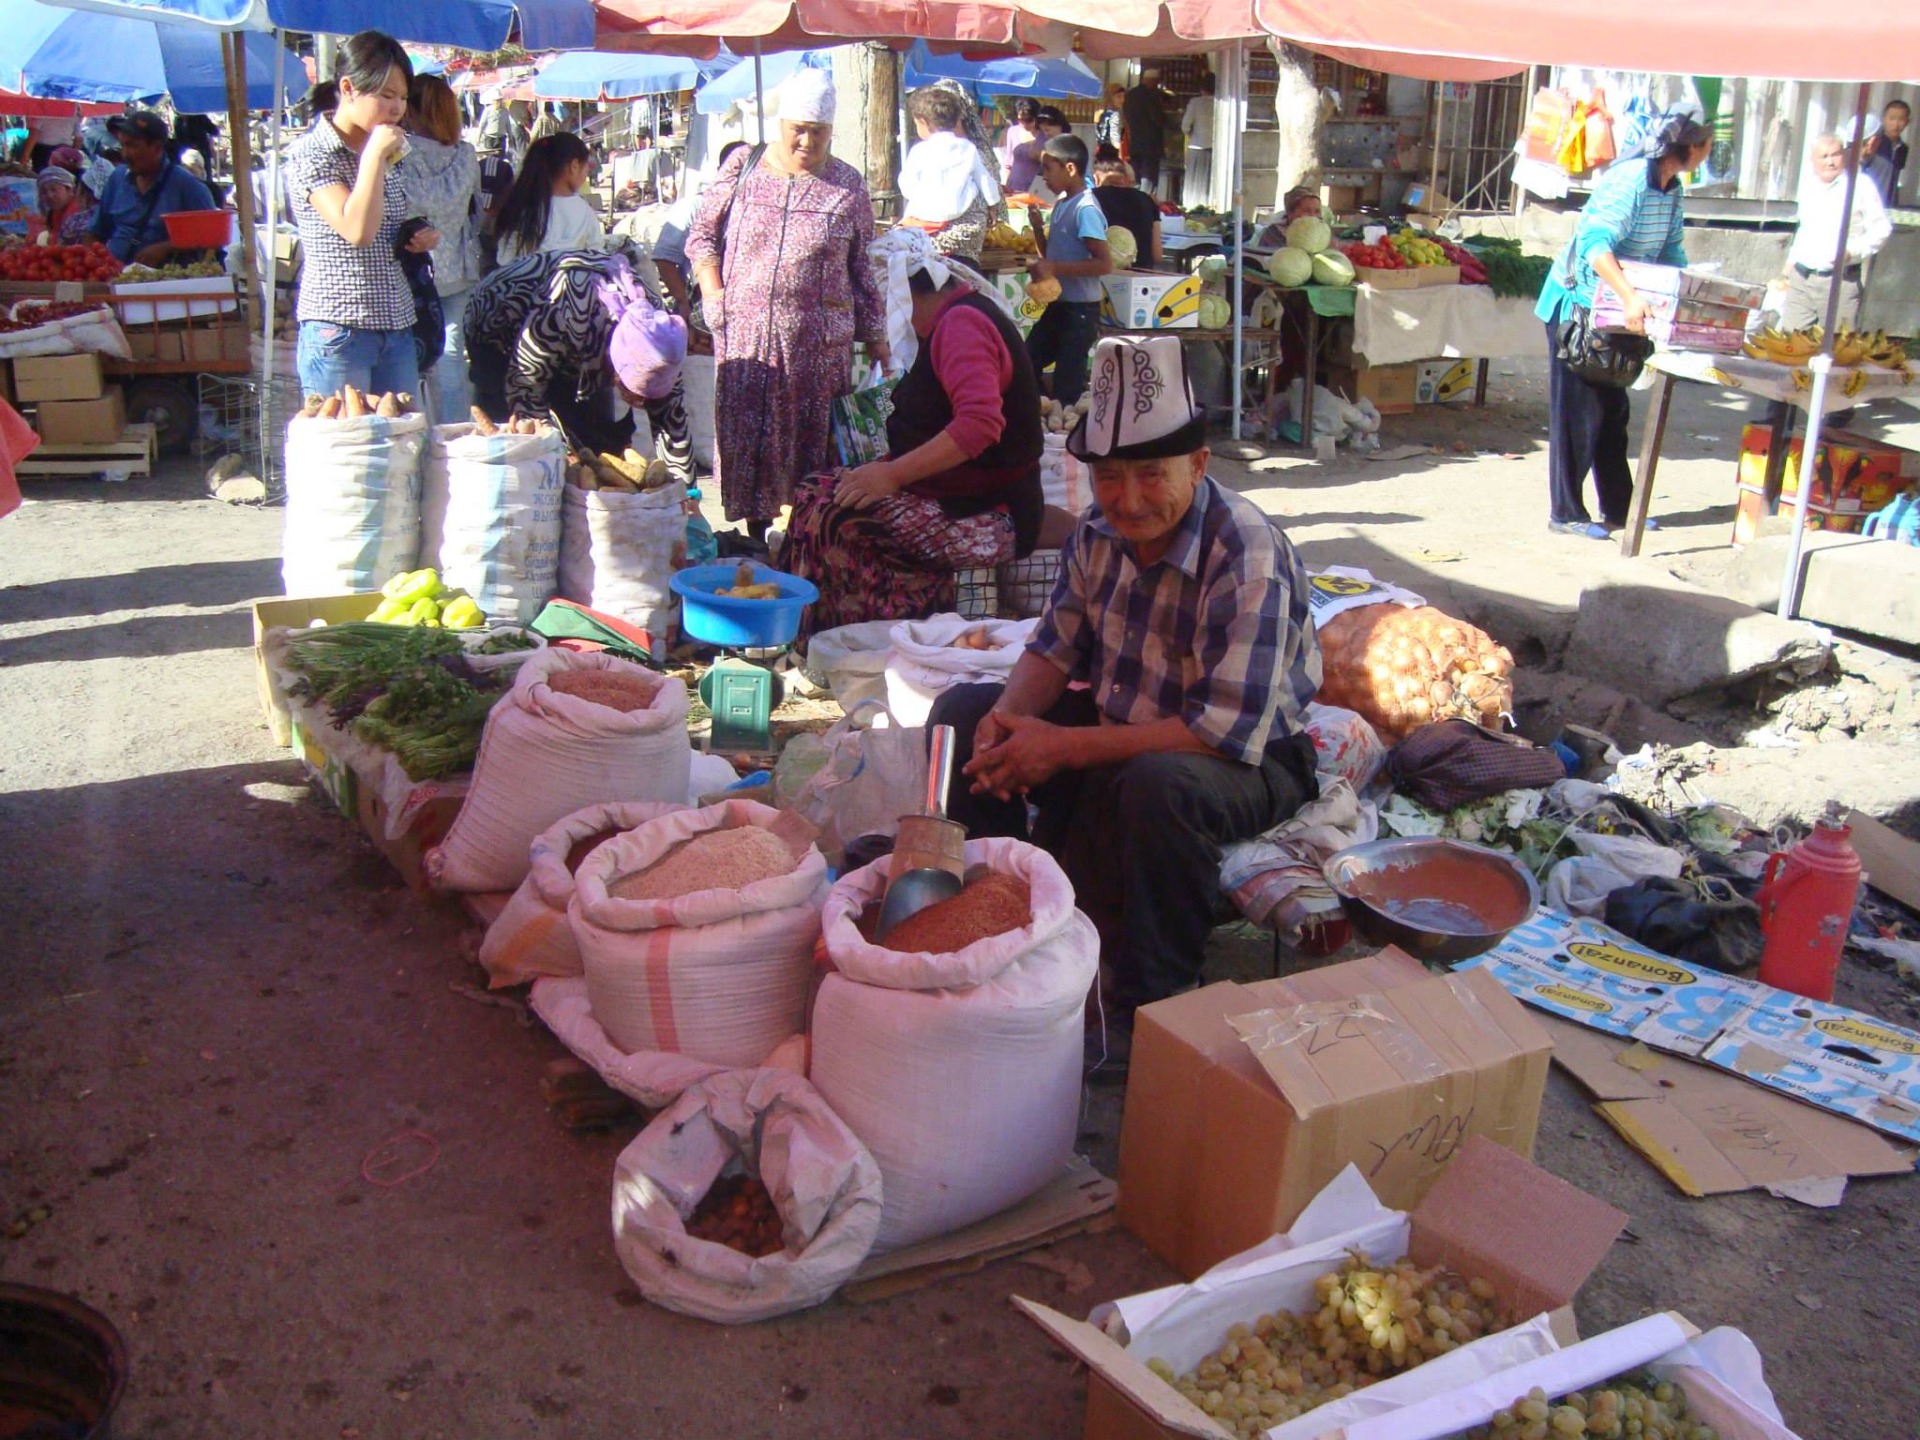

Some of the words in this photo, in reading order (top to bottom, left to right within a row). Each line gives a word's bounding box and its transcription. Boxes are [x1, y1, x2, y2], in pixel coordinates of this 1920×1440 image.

[1508, 945, 1565, 974] Bonanza!
[1576, 943, 1685, 985] Bonanza!
[1581, 968, 1643, 995] Bonanza!
[1540, 985, 1607, 1012] Bonanza!
[1821, 1019, 1916, 1054] Bonanza!
[1819, 1050, 1890, 1083] Bonanza!
[1763, 1073, 1834, 1104] Bonanza!
